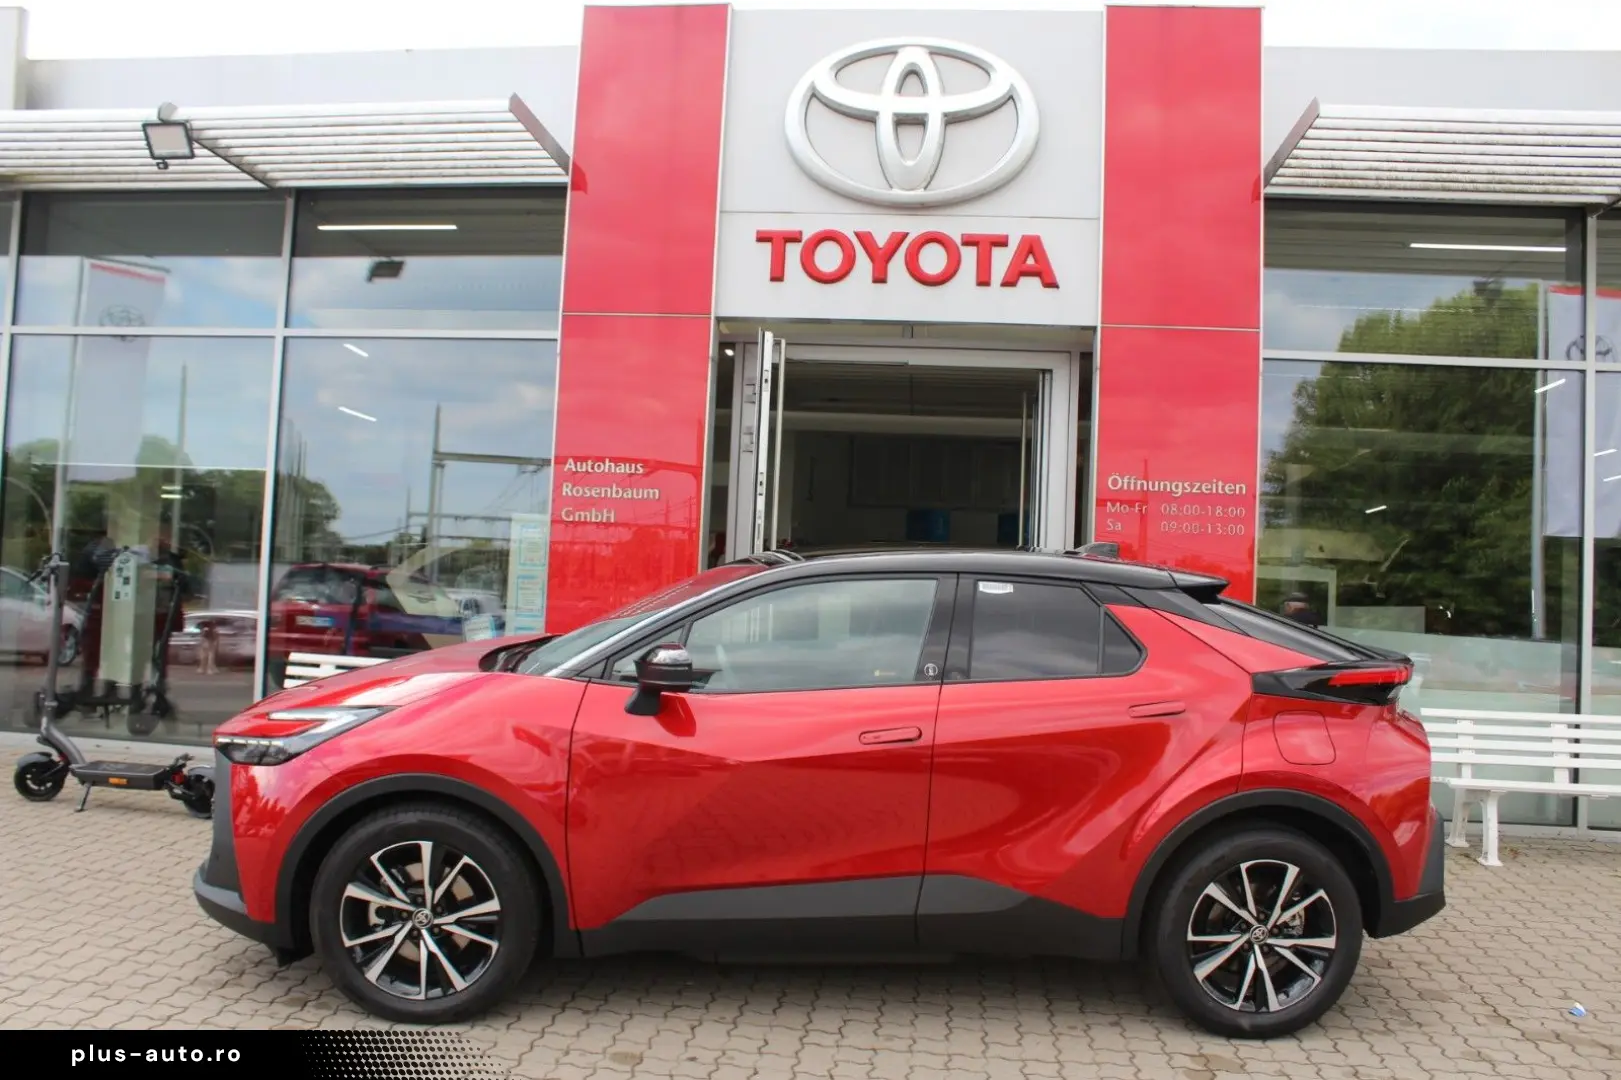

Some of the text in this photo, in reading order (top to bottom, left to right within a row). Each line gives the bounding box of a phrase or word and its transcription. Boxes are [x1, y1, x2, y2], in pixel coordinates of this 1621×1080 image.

[756, 229, 1060, 289] TOYOTA
[564, 458, 644, 474] Autohaus
[562, 482, 659, 499] Rosenbaum
[1107, 472, 1246, 497] Öffnungszeiten
[561, 507, 616, 523] GmbH
[1161, 503, 1245, 518] 08:00-18:00
[1106, 518, 1245, 536] Sa 09:00-13:00
